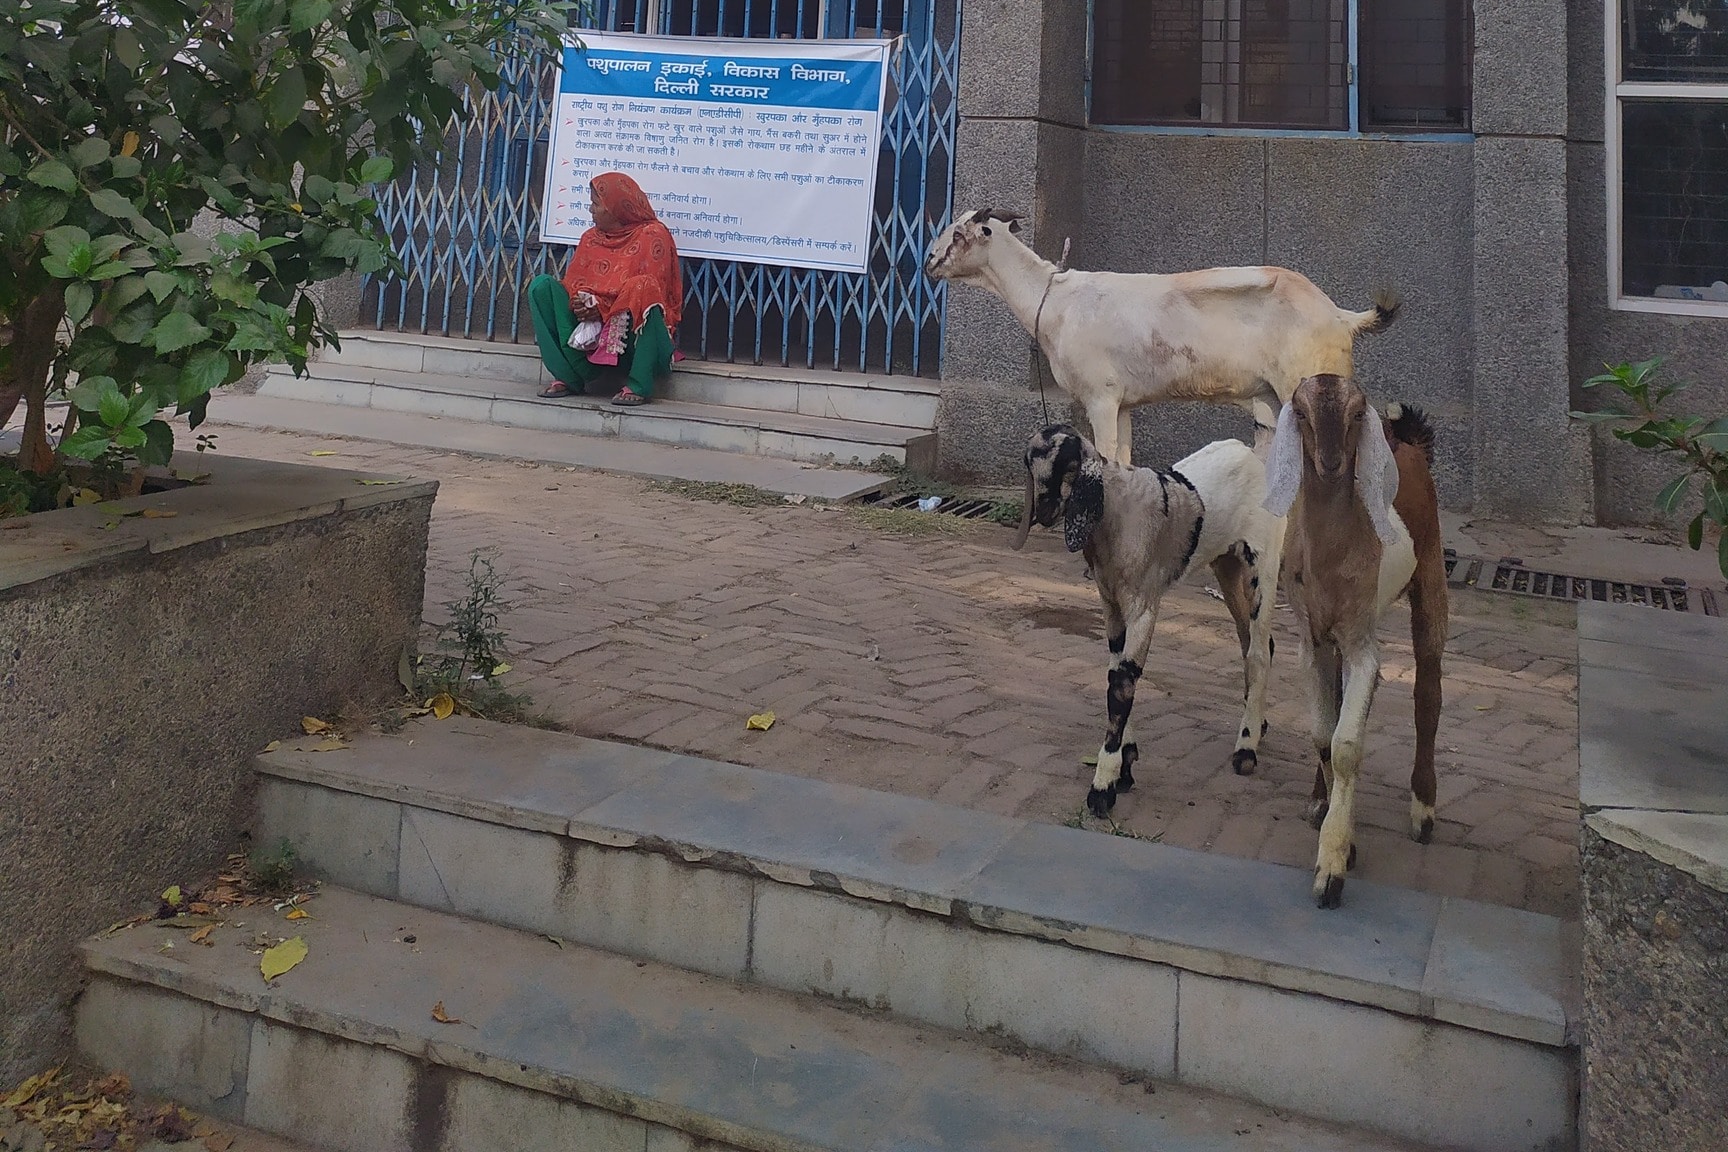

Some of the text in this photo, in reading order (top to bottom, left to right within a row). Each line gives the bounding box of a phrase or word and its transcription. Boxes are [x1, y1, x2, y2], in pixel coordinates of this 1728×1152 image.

[587, 57, 850, 84] पशुपालन इकाई, विकास विभाग,
[654, 77, 770, 99] दिल्ली सरकार
[572, 99, 593, 112] राष्ट्रीय
[597, 102, 608, 113] पशु
[611, 101, 624, 112] रोग
[660, 104, 692, 116] कार्यक्रम
[756, 112, 787, 124] खुरपका
[791, 112, 807, 123] और
[847, 115, 862, 126] रोग
[603, 118, 614, 127] और
[642, 120, 654, 129] रोग
[693, 135, 705, 145] रोग
[722, 138, 743, 148] इसकी
[599, 158, 611, 167] और
[702, 165, 714, 176] और
